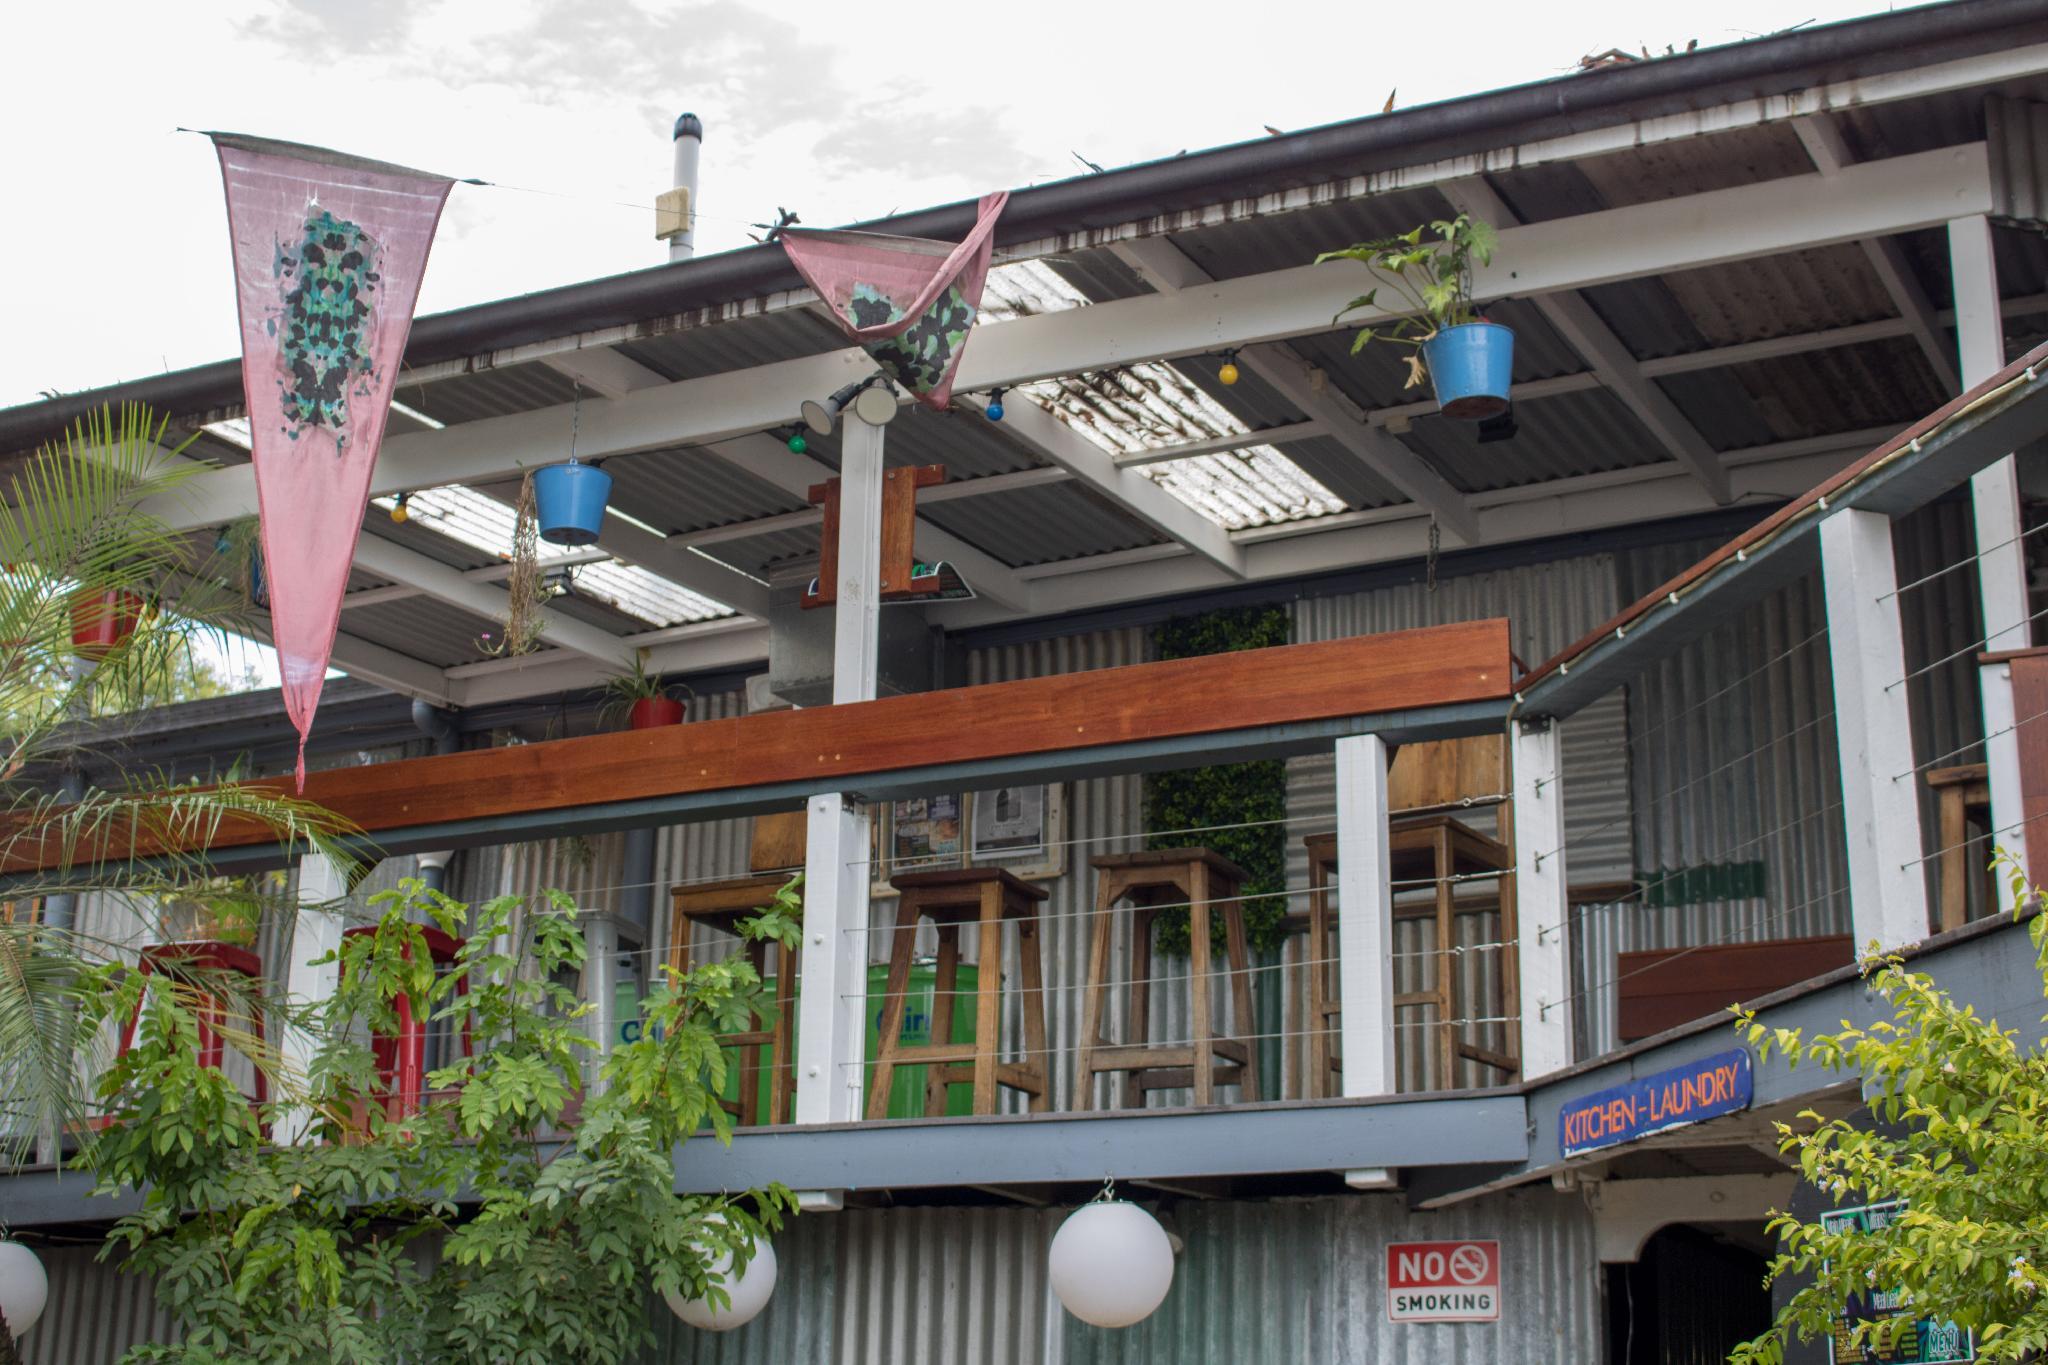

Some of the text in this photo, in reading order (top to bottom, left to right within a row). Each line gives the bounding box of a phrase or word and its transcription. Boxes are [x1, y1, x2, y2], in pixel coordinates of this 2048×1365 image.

[1398, 1251, 1445, 1282] NO
[1397, 1294, 1490, 1311] SMOKING
[1928, 1328, 1959, 1354] MENU
